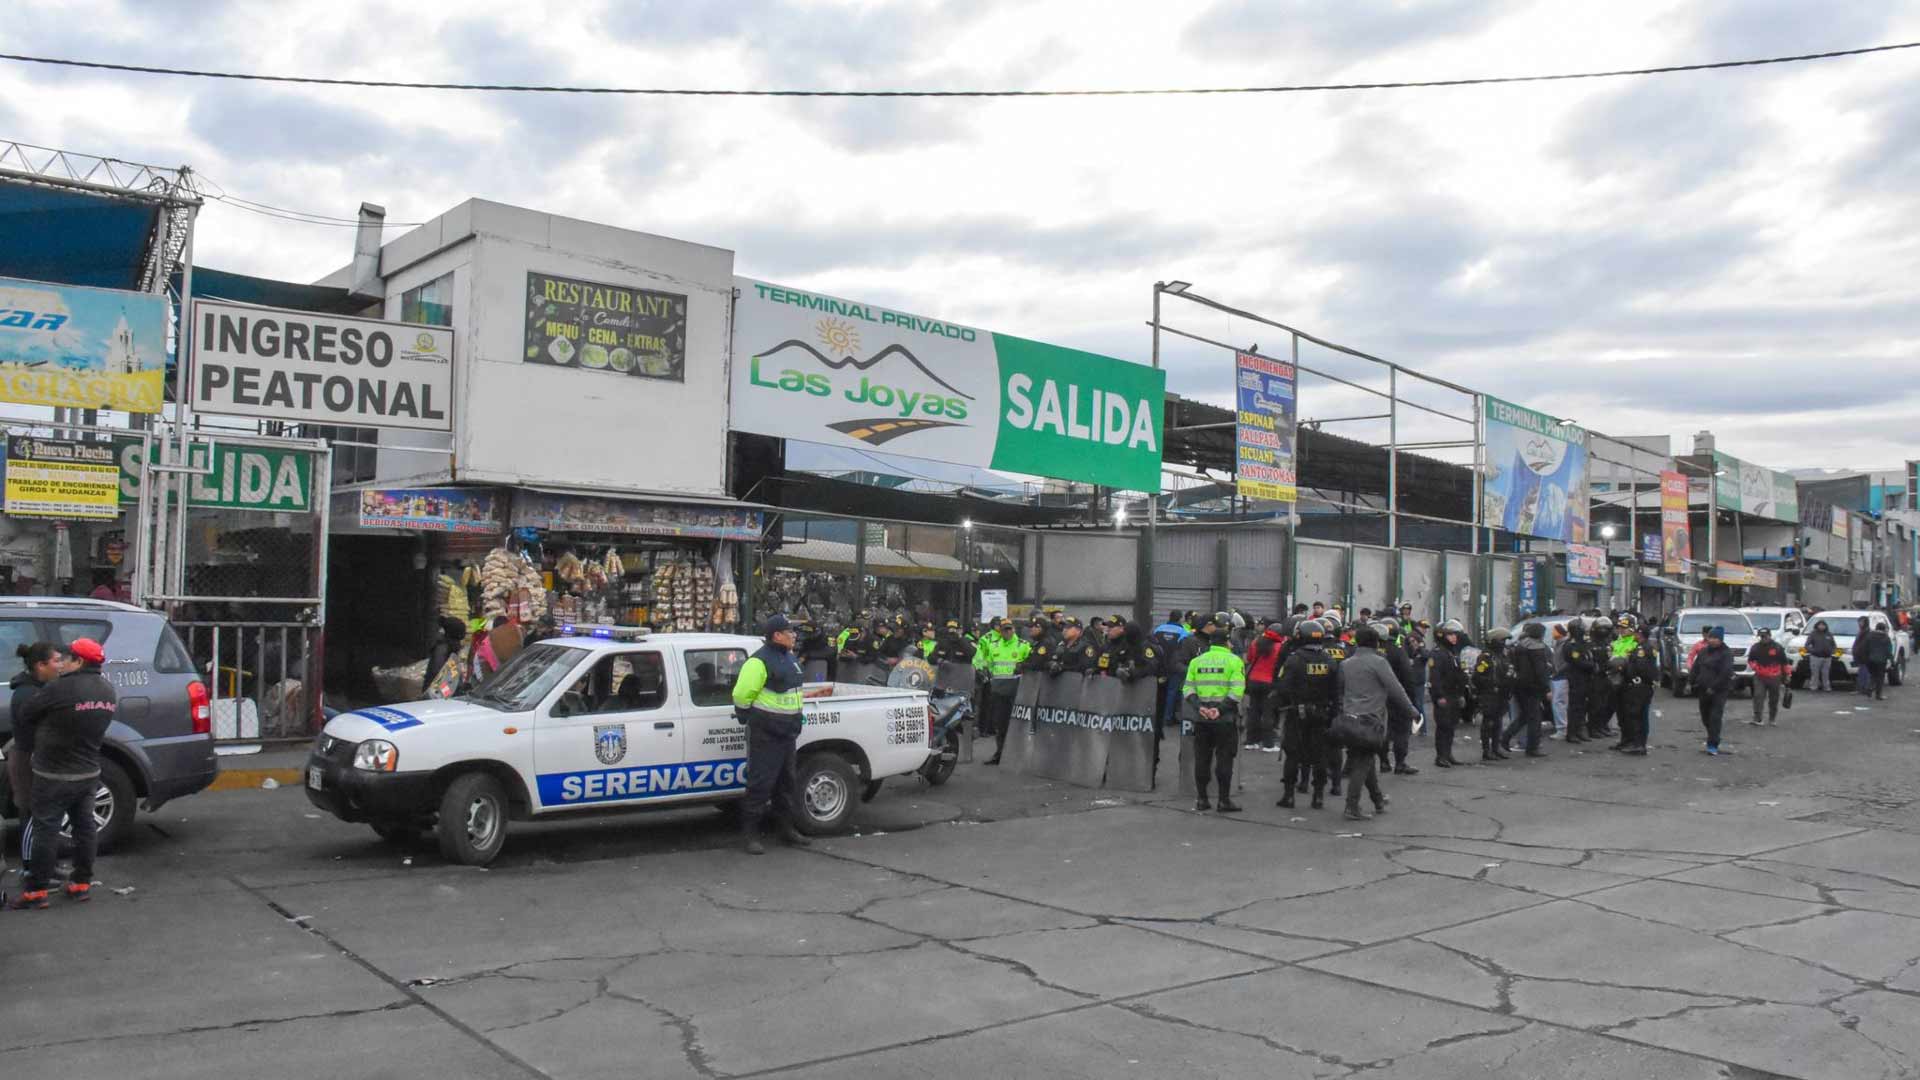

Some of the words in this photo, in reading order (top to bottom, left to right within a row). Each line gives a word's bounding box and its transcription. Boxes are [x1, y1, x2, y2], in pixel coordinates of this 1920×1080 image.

[544, 279, 672, 319] RESTAURANT
[0, 308, 69, 331] AR
[754, 284, 878, 323] TERMINAL
[882, 311, 977, 343] PRIVADO
[204, 313, 394, 369] INGRESO
[588, 327, 617, 345] CENA
[627, 333, 666, 350] EXTRAS
[1238, 353, 1294, 380] ENCOMIENDAS
[201, 363, 444, 420] PEATONAL
[749, 356, 832, 397] Las
[844, 376, 968, 420] Joyas
[1006, 372, 1157, 453] SALIDA
[1239, 410, 1274, 430] ESPINAR
[1491, 401, 1544, 432] TERMINAL
[1545, 419, 1584, 446] PRIVADO
[1239, 427, 1280, 448] PALLPATA
[74, 444, 113, 460] Flecha
[1239, 446, 1273, 464] SICUANI
[8, 478, 48, 487] TRASLADO
[50, 480, 61, 488] DE
[120, 444, 305, 506] SLIDA
[19, 486, 47, 494] GIROS
[58, 488, 107, 497] MUDANZAS
[363, 518, 402, 527] BEBIDAS
[819, 712, 830, 724] 664
[894, 707, 904, 719] 054
[1037, 707, 1077, 726] POLICIA
[708, 726, 745, 735] MUNICIPALIDA
[895, 720, 905, 732] 054
[717, 736, 728, 744] LUIS
[895, 732, 905, 744] 054
